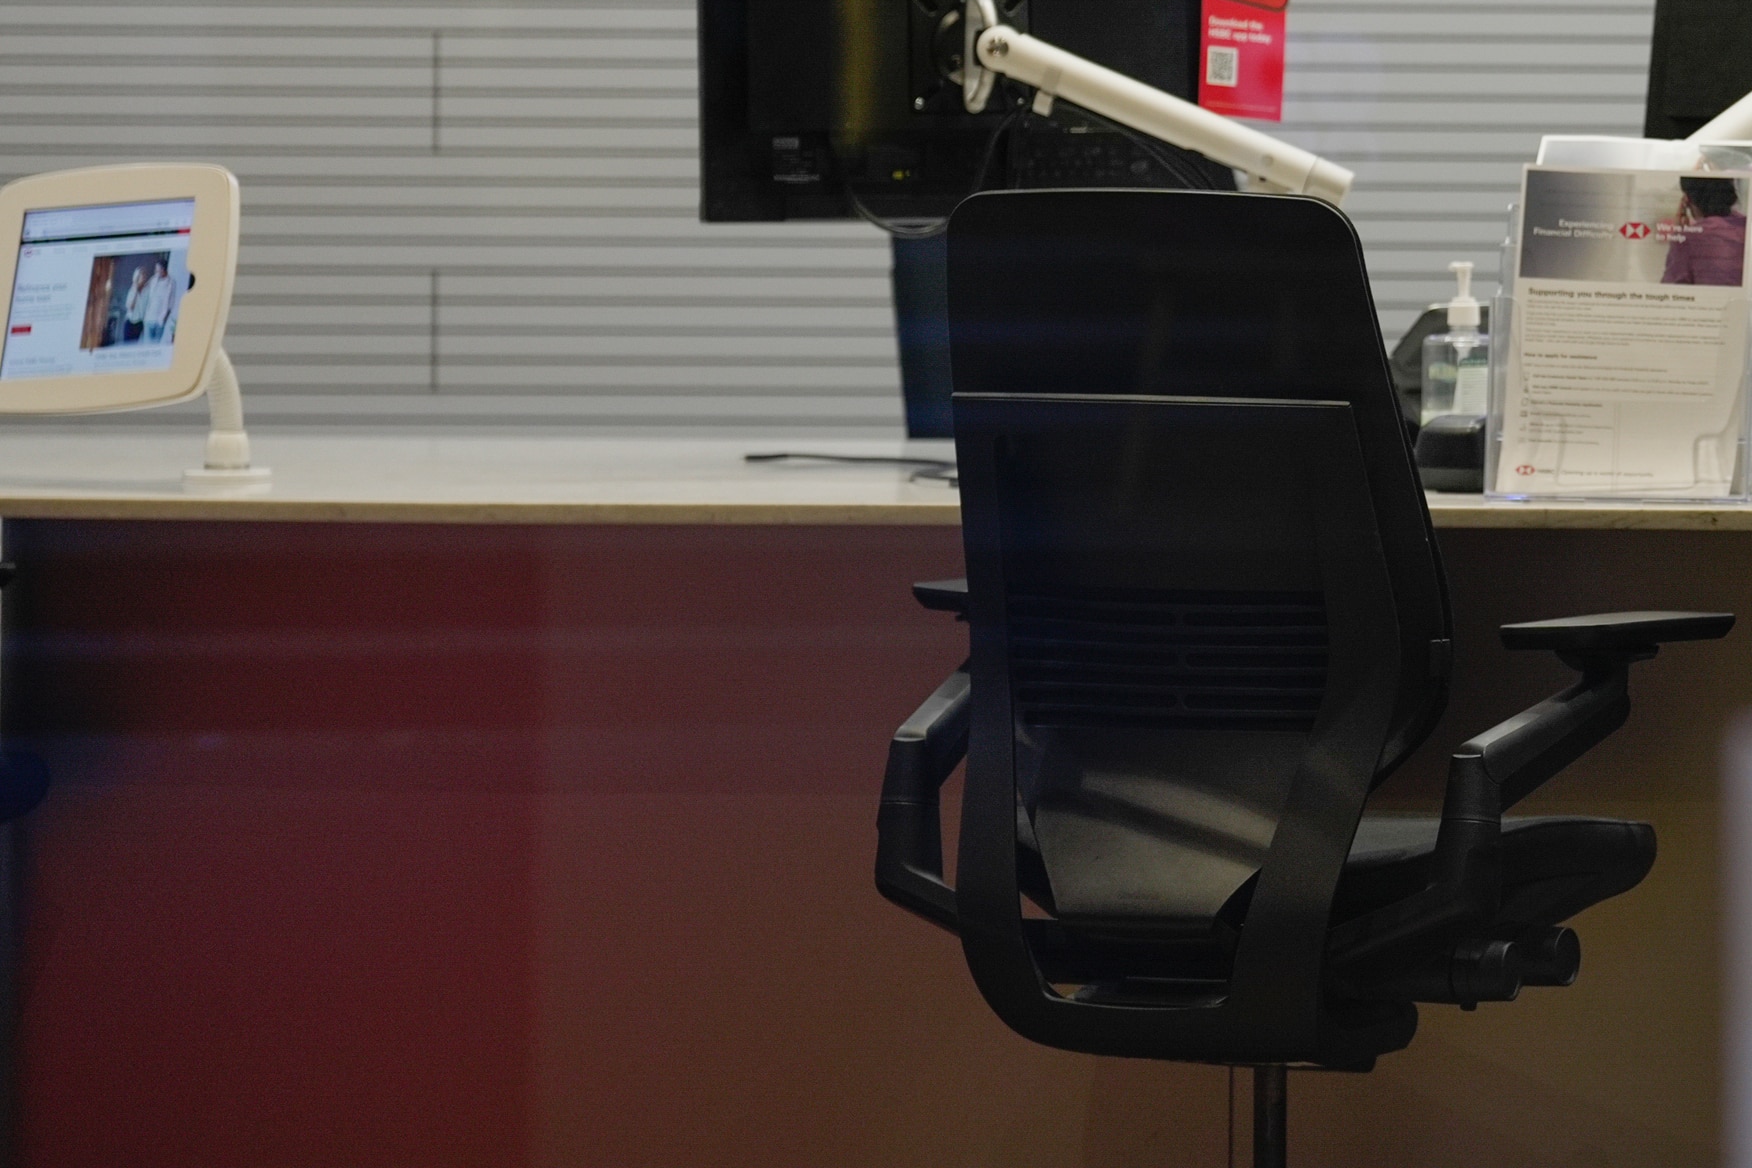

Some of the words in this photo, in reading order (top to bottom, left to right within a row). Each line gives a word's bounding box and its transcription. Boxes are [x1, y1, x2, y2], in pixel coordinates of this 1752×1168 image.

[1533, 226, 1572, 238] Financial
[1667, 232, 1687, 244] help
[1528, 288, 1575, 298] Supporting
[1577, 291, 1592, 299] you
[1594, 290, 1628, 300] through
[1630, 292, 1643, 300] the
[1645, 293, 1670, 302] tough
[1672, 294, 1695, 302] times
